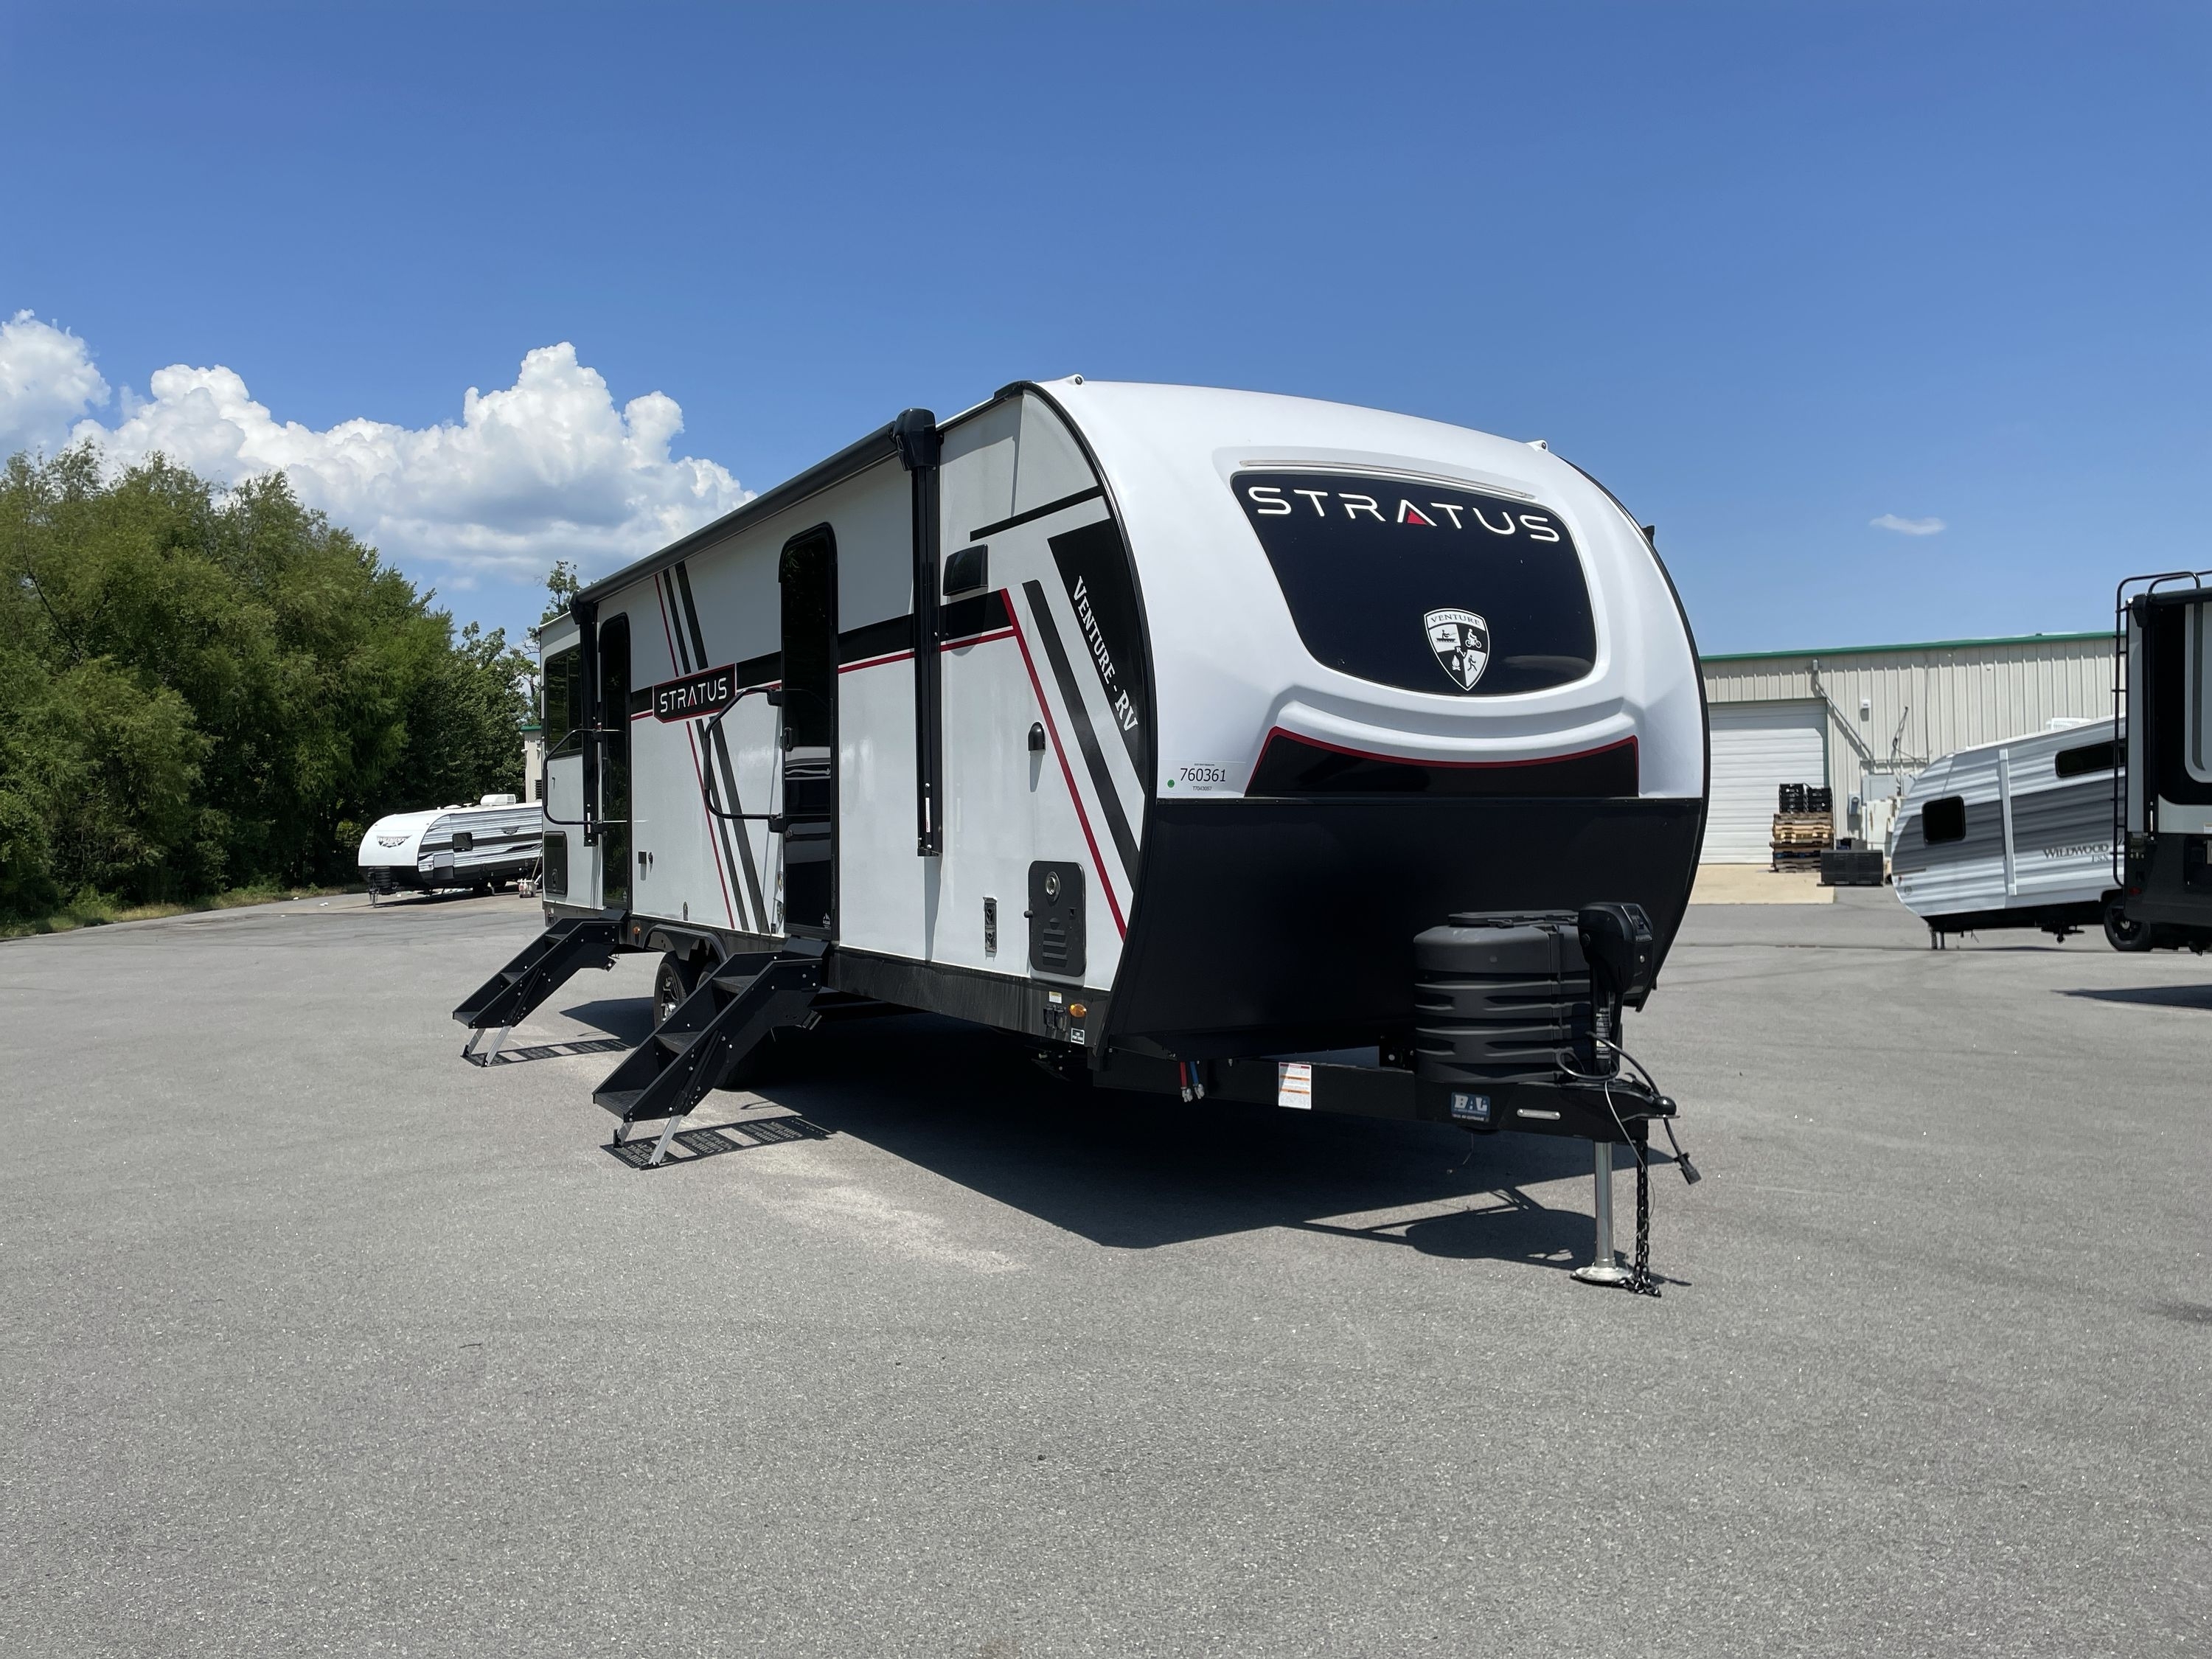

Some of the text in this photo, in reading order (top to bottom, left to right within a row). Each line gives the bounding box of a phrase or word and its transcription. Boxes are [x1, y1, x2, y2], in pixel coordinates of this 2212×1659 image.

[1248, 487, 1560, 543] STRATUS
[1431, 613, 1481, 627] VENTURE
[1074, 575, 1116, 684] VENTURE
[1115, 689, 1138, 731] RV
[660, 677, 726, 713] STRATUS
[1180, 768, 1226, 782] 760361
[2042, 843, 2109, 858] WILDWOOD
